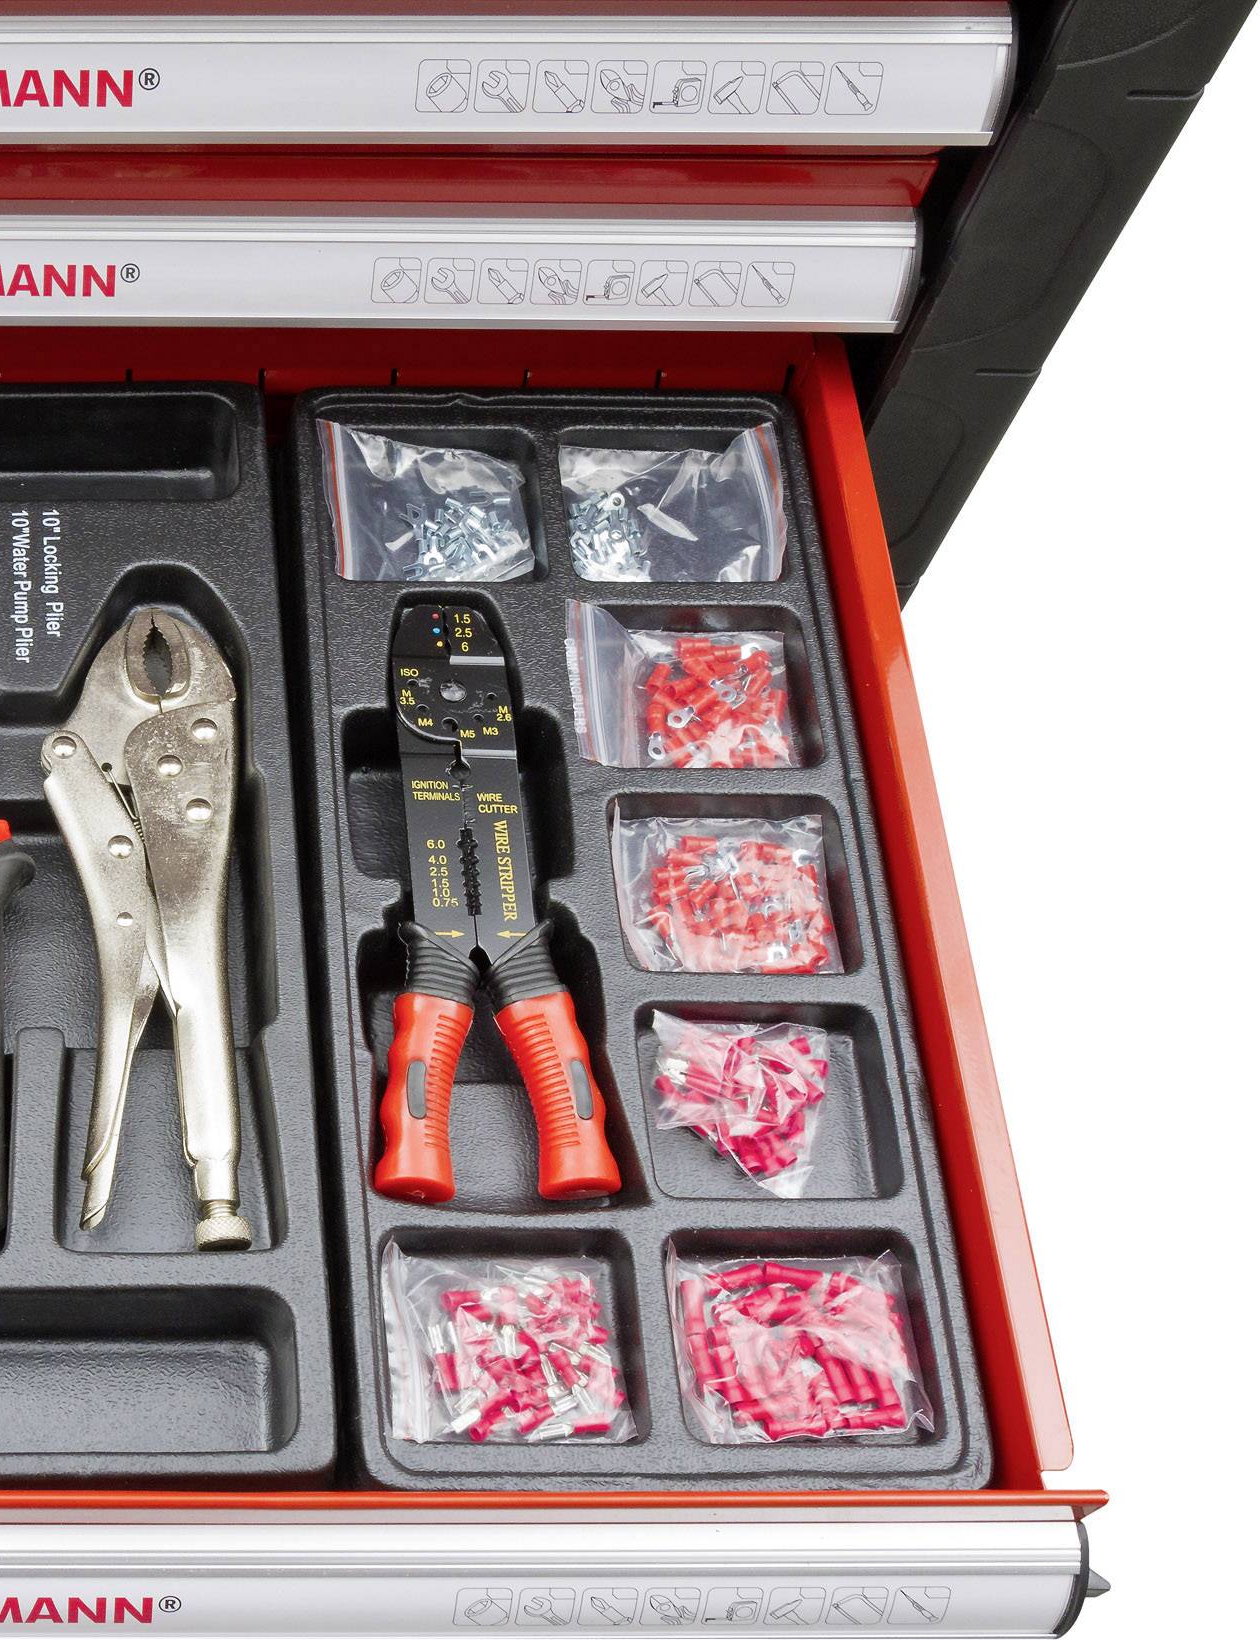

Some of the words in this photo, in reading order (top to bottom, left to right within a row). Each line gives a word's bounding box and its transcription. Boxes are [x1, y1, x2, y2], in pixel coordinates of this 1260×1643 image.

[41, 536, 62, 594] Locking
[10, 580, 32, 624] Pump
[46, 601, 64, 637] Plier
[454, 613, 471, 624] 1.5
[454, 627, 472, 638] 2.5
[15, 627, 34, 663] Plier
[461, 641, 469, 652] 6
[400, 668, 419, 677] ISO
[402, 689, 411, 697] M
[399, 696, 416, 705] 3.5
[498, 705, 508, 714] M
[417, 718, 434, 727] M4
[496, 713, 512, 722] 2.6
[460, 730, 476, 738] M5
[483, 727, 499, 736] M3
[411, 780, 449, 790] IGNITION
[412, 791, 461, 801] TERMINALS
[476, 793, 503, 802] WIRE
[478, 804, 518, 814] CUTTER
[493, 820, 510, 854] WIRE
[426, 839, 446, 849] 6.0
[428, 855, 447, 865] 4.0
[429, 867, 448, 877] 2.5
[431, 878, 449, 888] 1.5
[432, 888, 450, 897] 1.0
[497, 857, 518, 921] STRIPPER
[432, 898, 459, 907] 0.75
